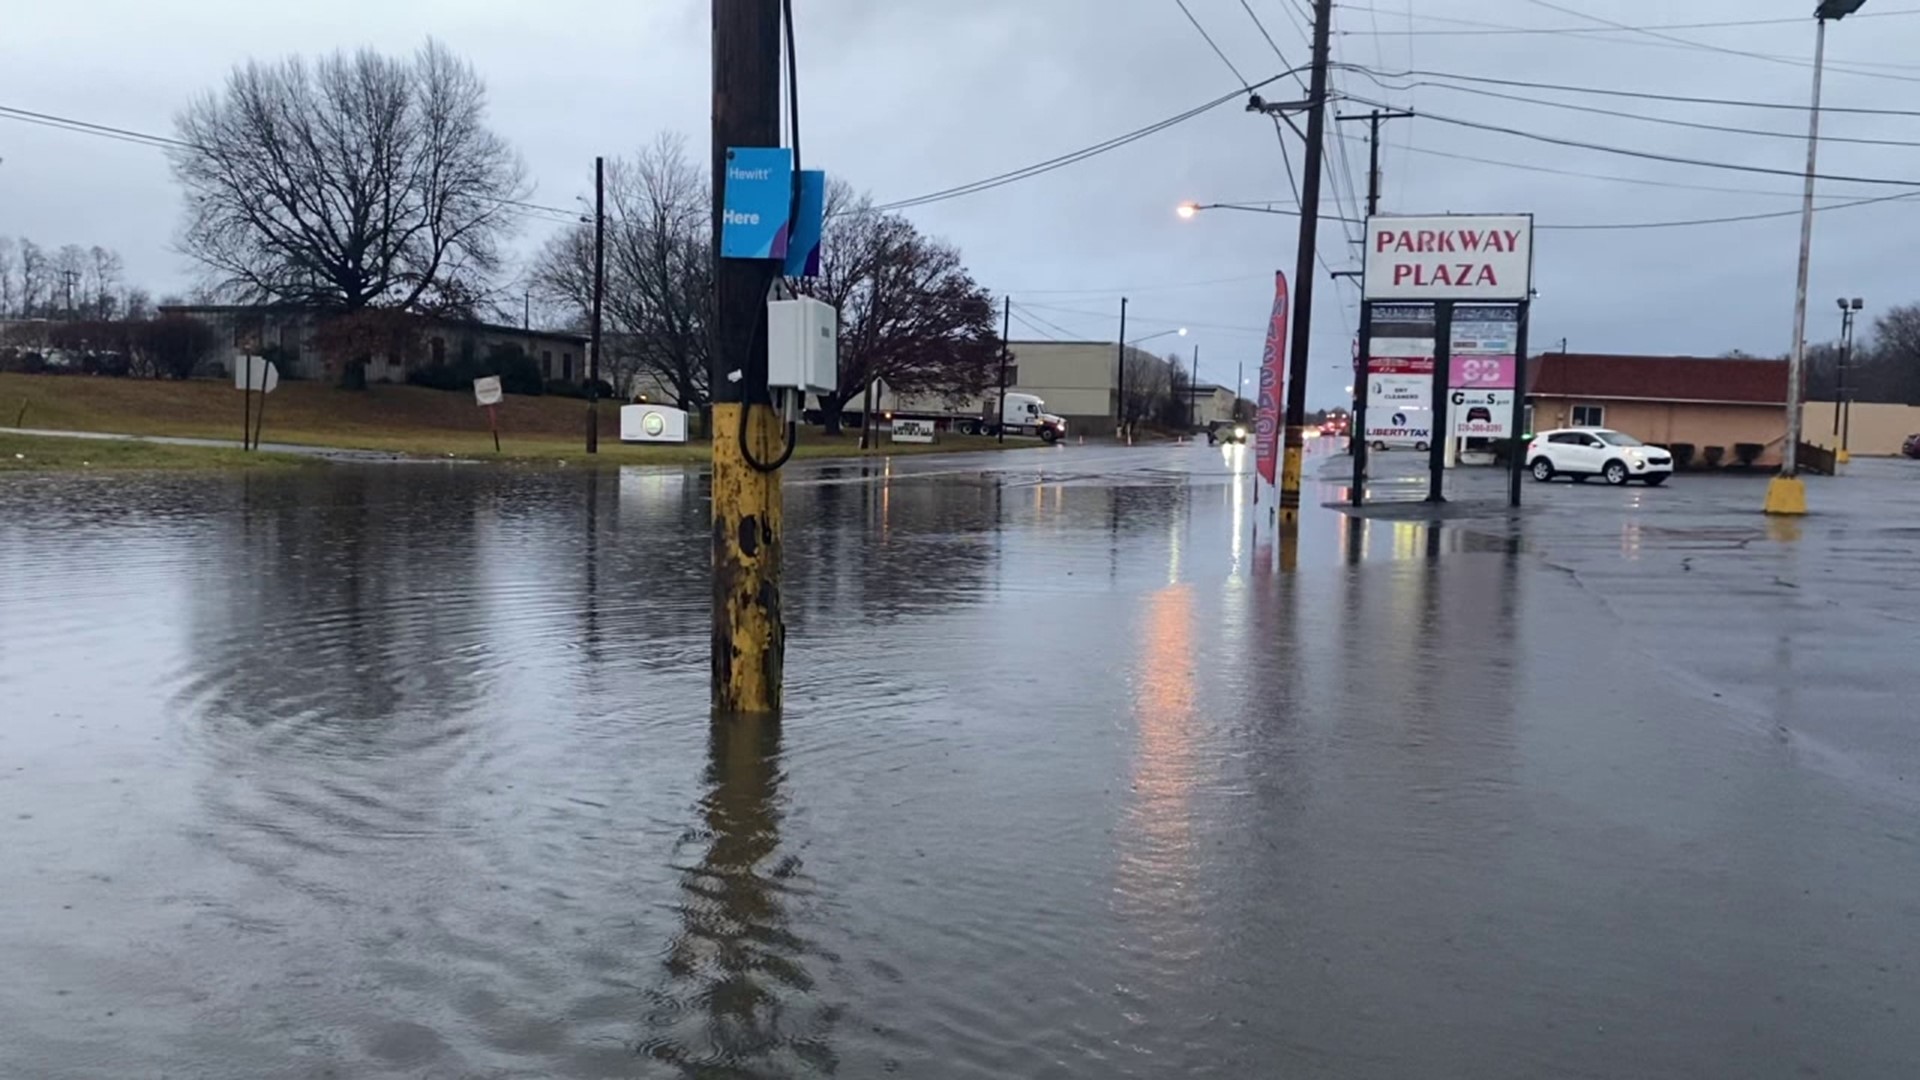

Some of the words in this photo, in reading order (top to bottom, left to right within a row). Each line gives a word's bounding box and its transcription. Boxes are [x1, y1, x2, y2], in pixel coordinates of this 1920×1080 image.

[723, 210, 760, 224] Here
[1376, 230, 1521, 253] PARKWAY
[1393, 264, 1498, 286] PLAZA
